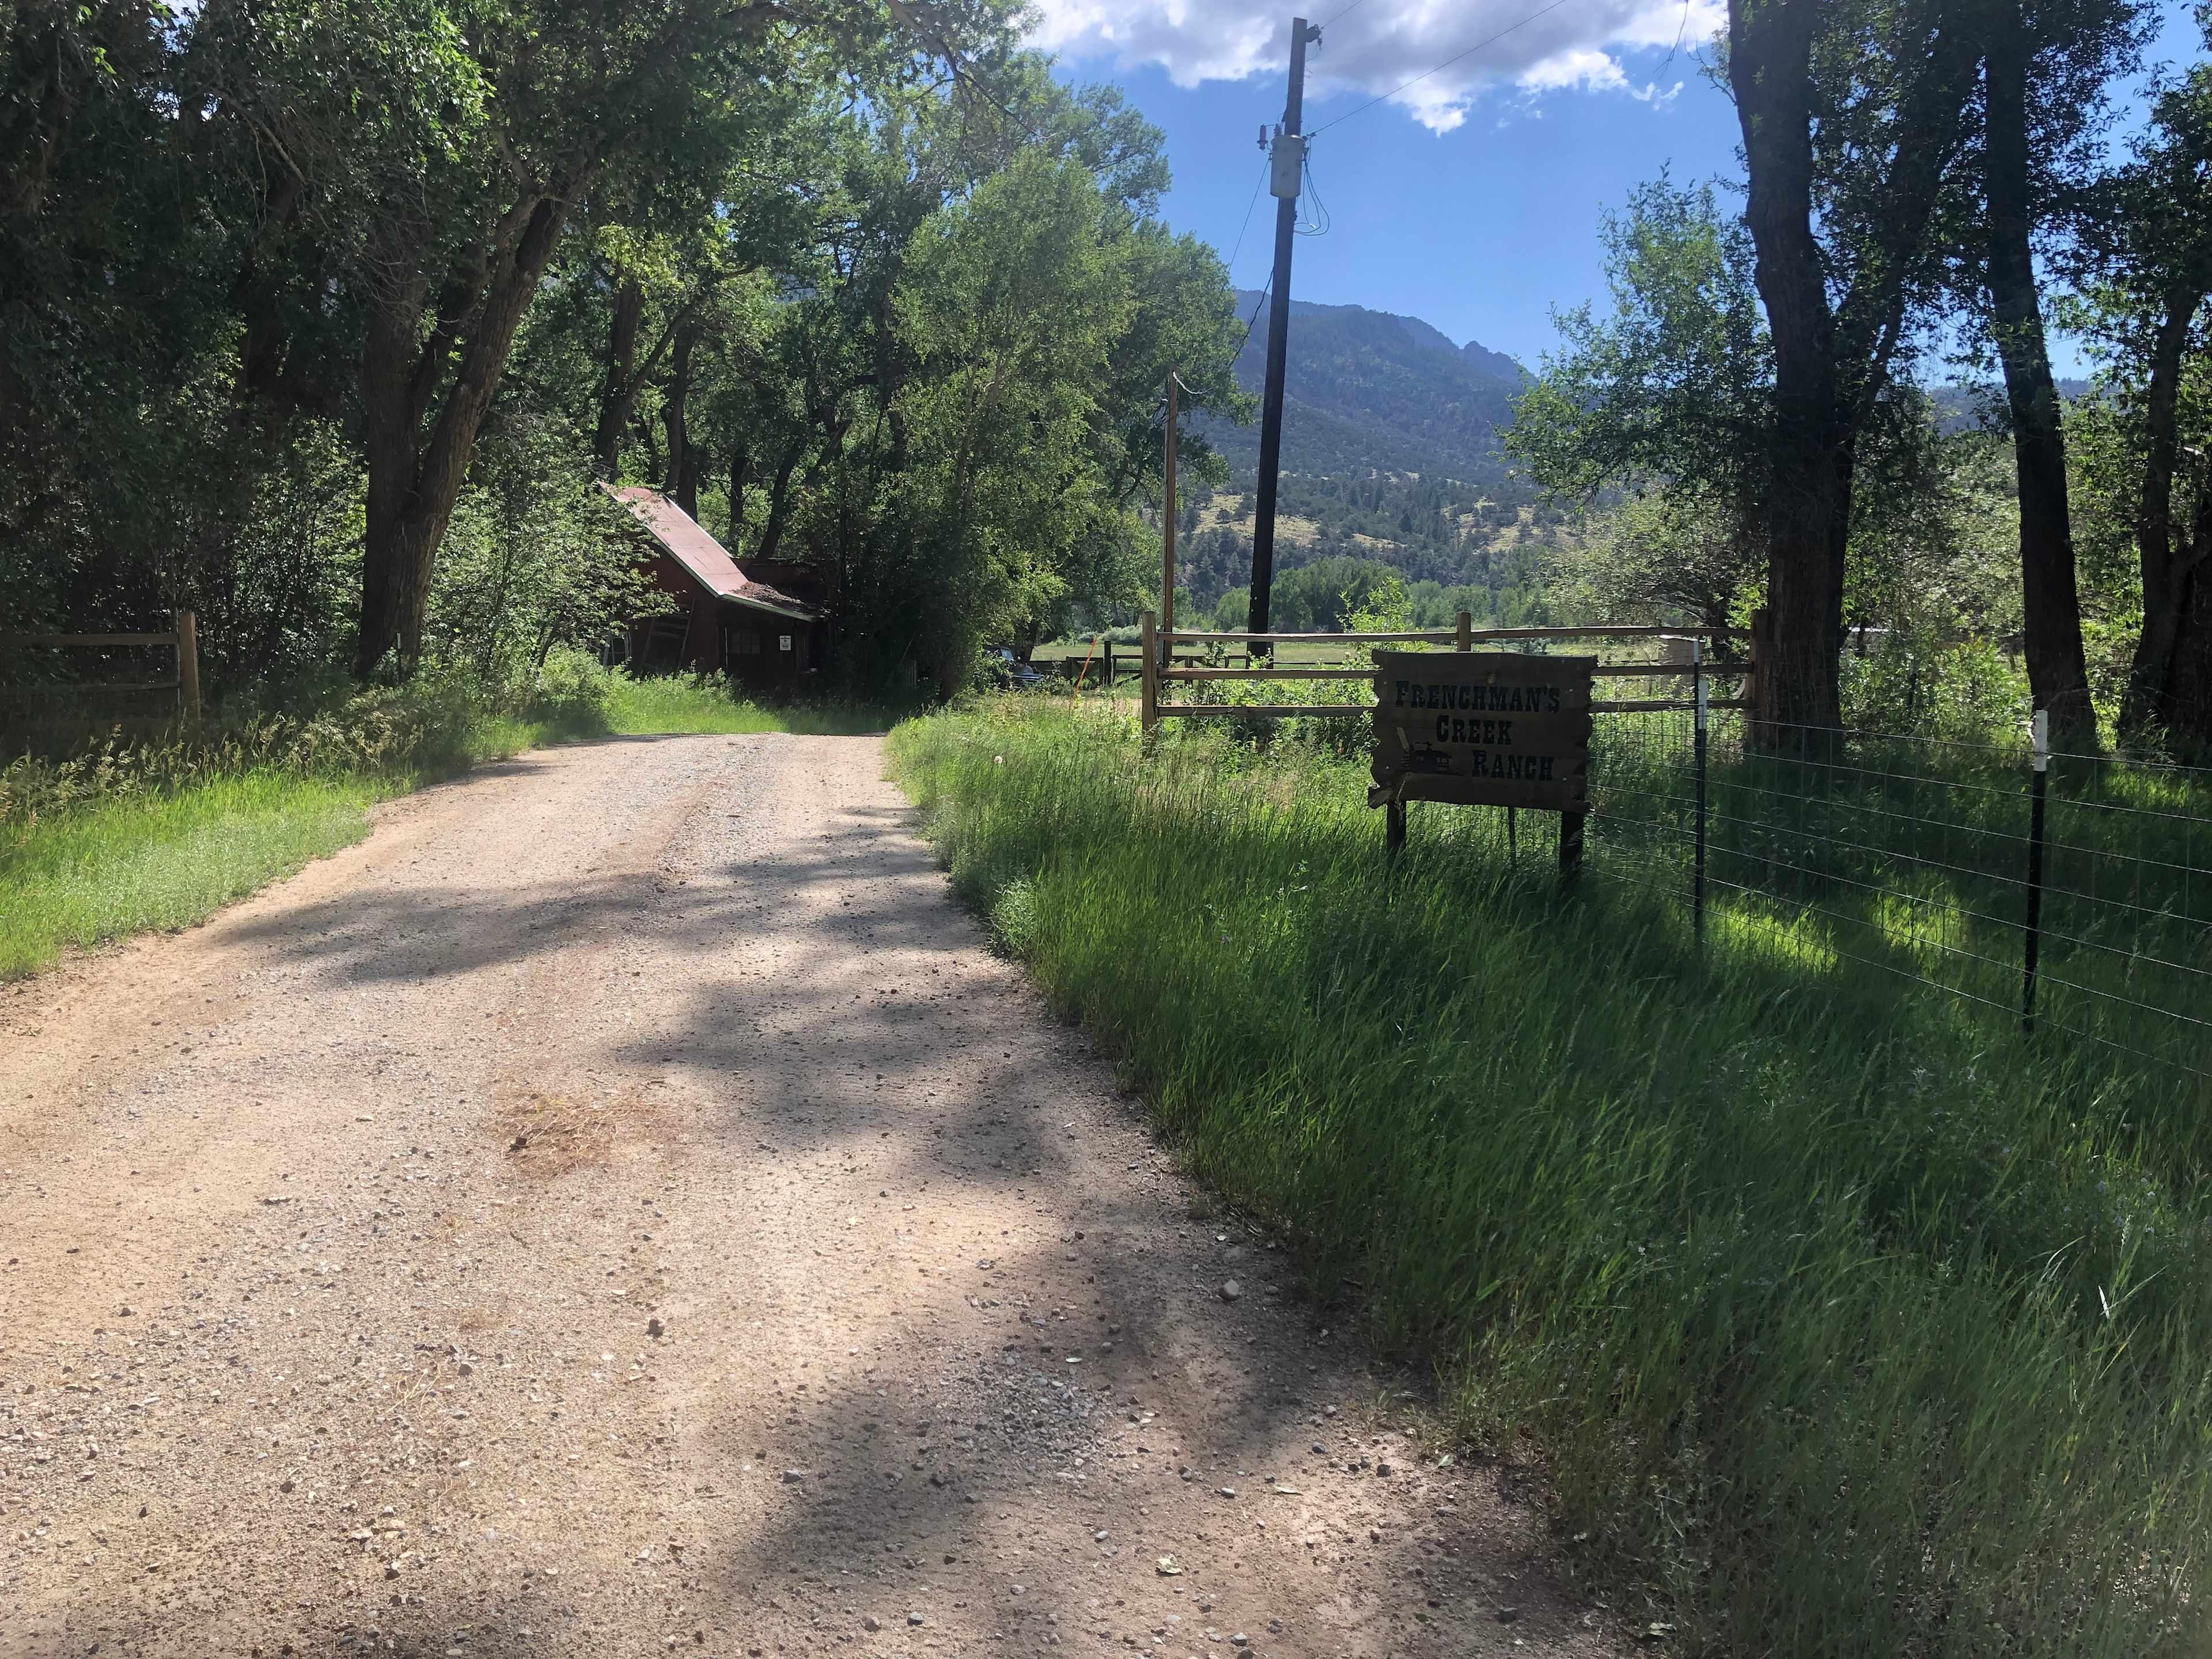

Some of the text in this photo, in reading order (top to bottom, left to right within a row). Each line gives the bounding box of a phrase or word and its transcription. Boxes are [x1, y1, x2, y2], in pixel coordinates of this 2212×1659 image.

[1396, 681, 1560, 714] FRENCHMAN'S
[1436, 715, 1512, 745] CREEK
[1472, 750, 1554, 781] RANCH
